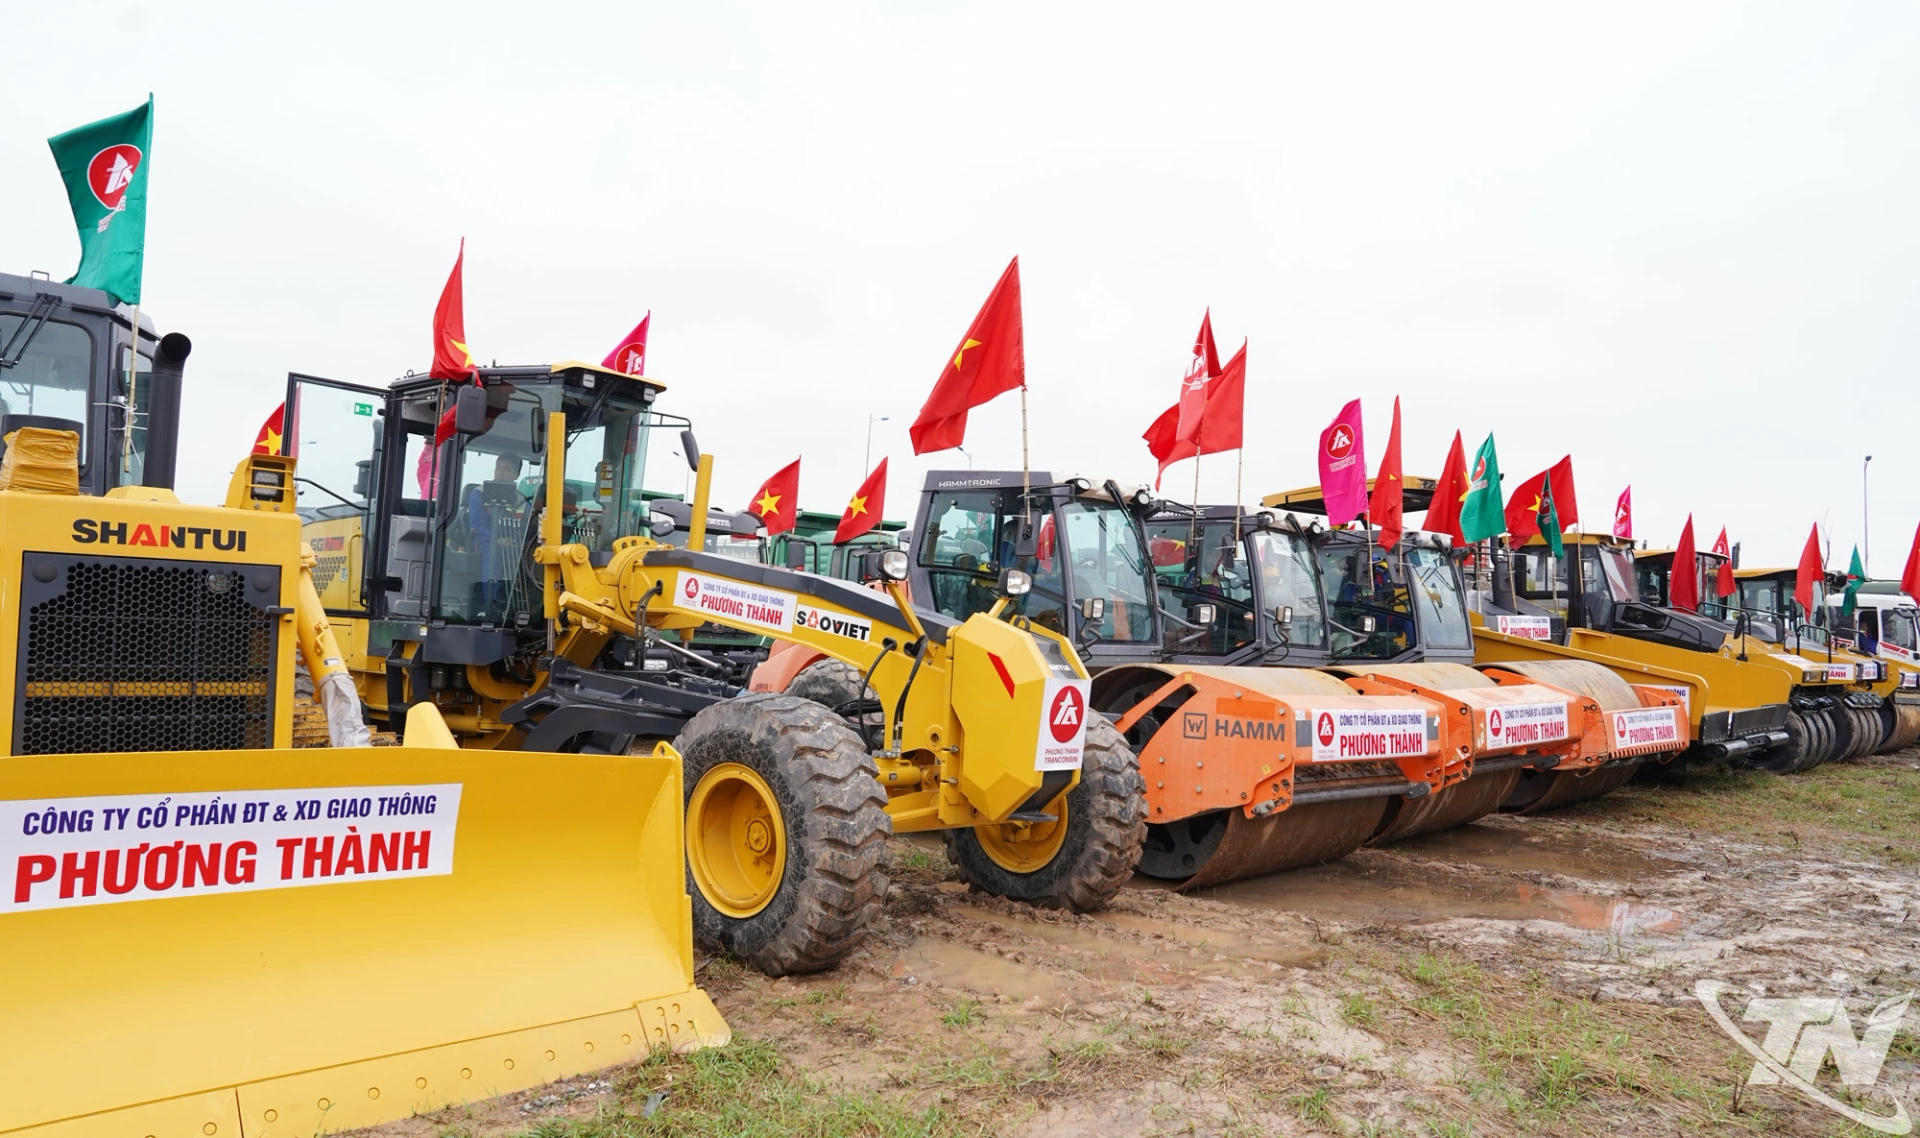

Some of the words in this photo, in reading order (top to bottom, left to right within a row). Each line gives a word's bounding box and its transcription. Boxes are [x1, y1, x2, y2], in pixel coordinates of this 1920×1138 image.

[938, 479, 1001, 487] HAMMTRONIC
[72, 519, 247, 552] SHANTUI
[701, 593, 744, 617] PHƯƠNG
[746, 604, 783, 626] THÀNH
[1215, 718, 1286, 742] HAMM
[1340, 732, 1386, 757] PHƯƠNG
[1389, 729, 1422, 754] THÀNH
[1505, 723, 1538, 744] PHƯƠNG
[1540, 719, 1565, 740] THÀNH
[1655, 723, 1674, 740] THÀNH
[23, 807, 93, 835] CÔNG
[102, 808, 130, 831] TY
[137, 797, 172, 829] CỔ
[175, 796, 236, 827] PHẦN
[243, 801, 271, 824] ĐT
[273, 805, 288, 821] &
[294, 800, 321, 821] XD
[326, 797, 371, 819] GIAO
[377, 791, 437, 816] THÔNG
[14, 839, 258, 904] PHƯƠNG
[276, 826, 432, 876] THÀNH
